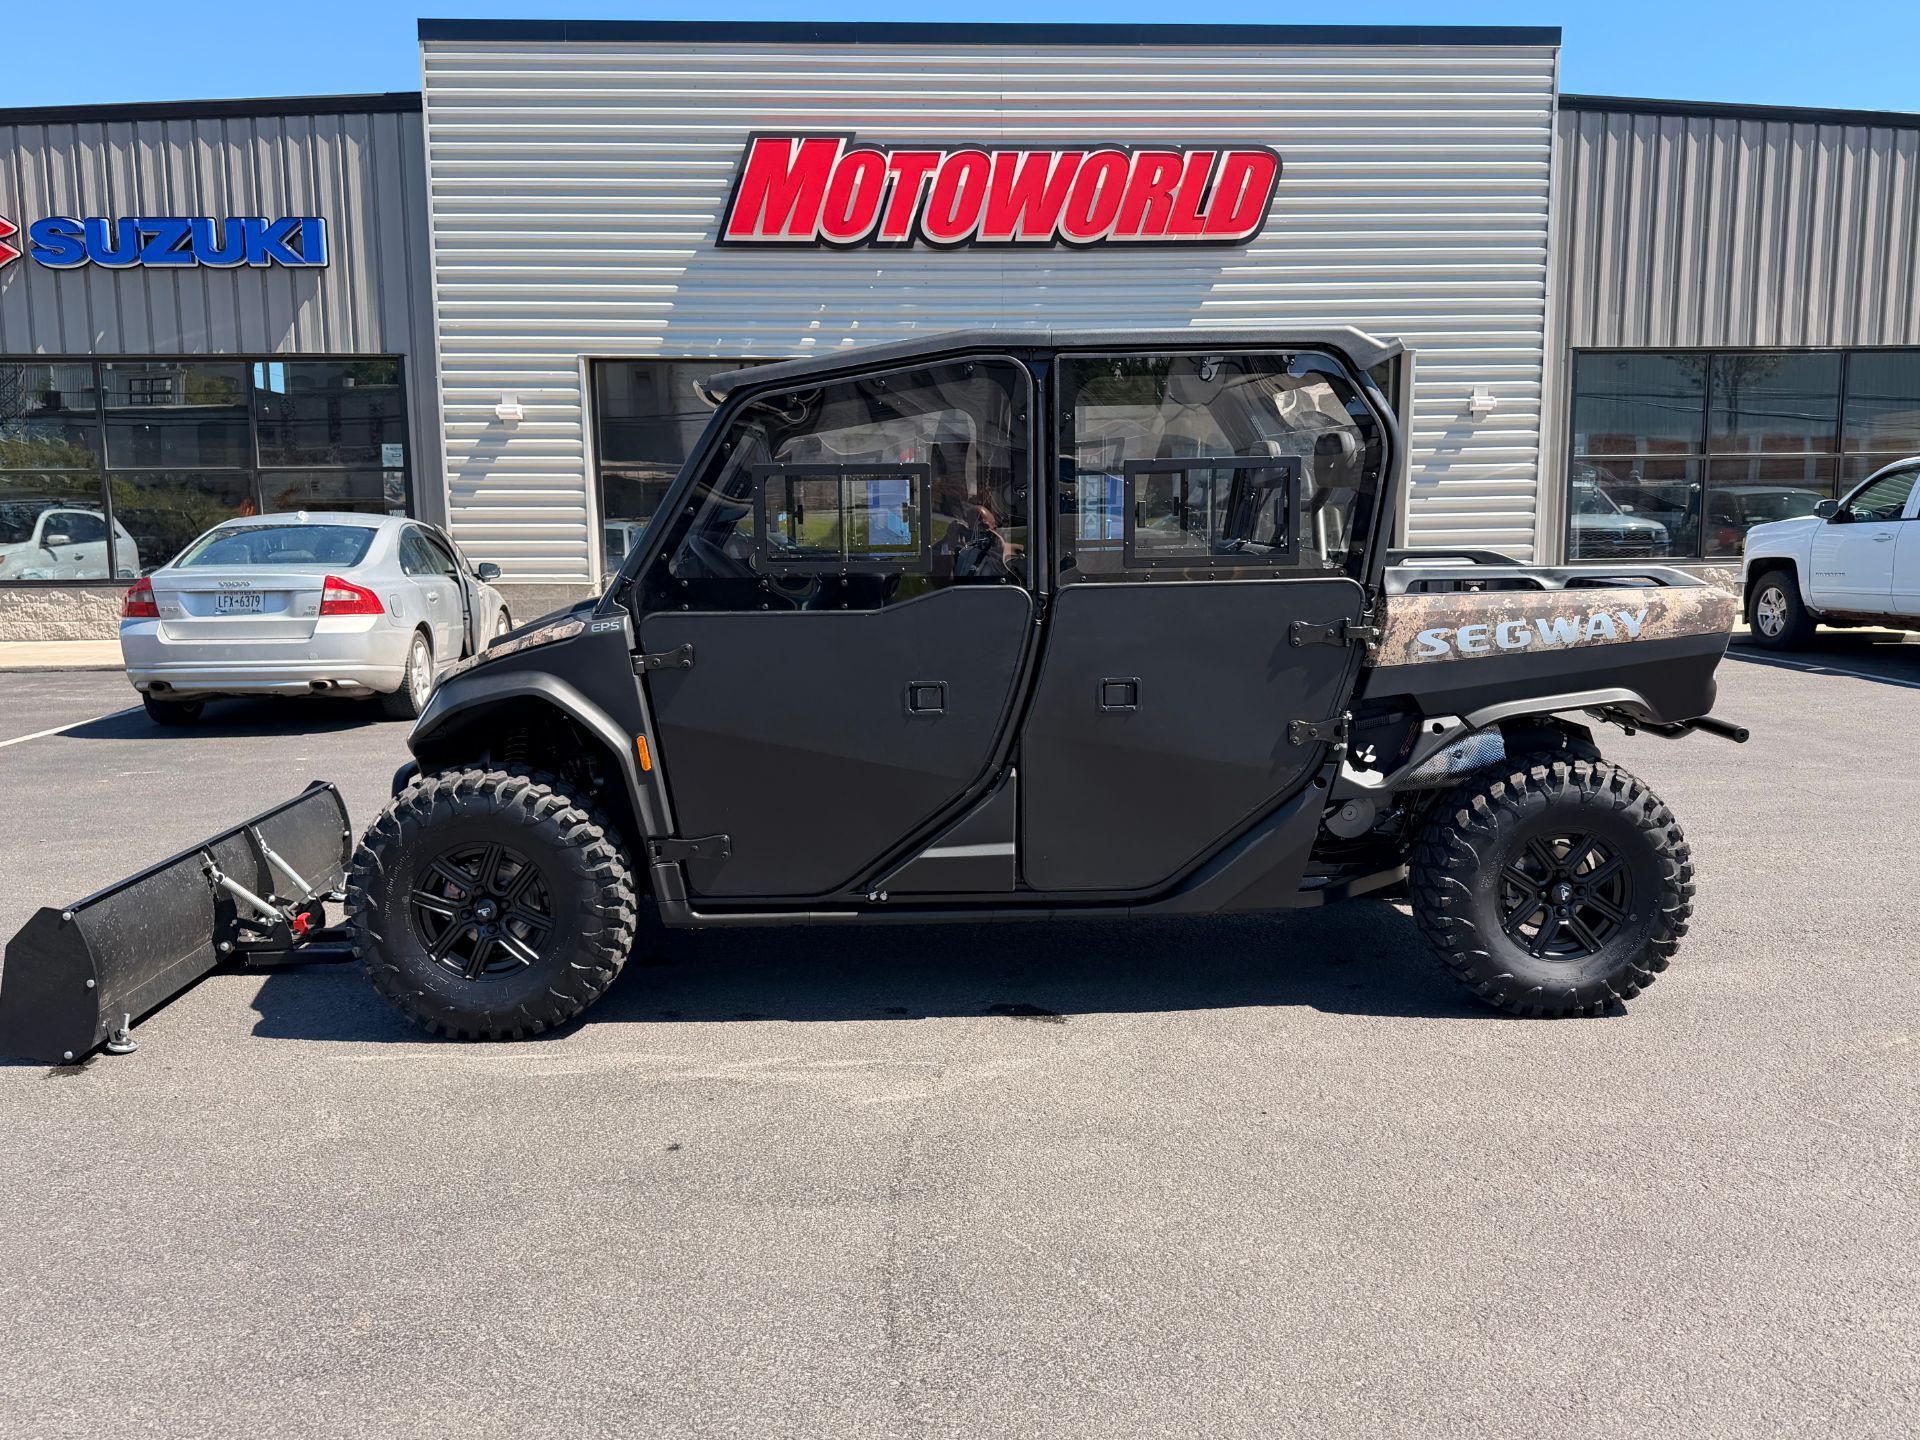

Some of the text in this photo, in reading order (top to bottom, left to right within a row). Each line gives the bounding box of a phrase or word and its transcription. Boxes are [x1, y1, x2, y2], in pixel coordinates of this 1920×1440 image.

[725, 136, 1279, 240] MOTOWORLD
[29, 216, 329, 268] SUZUKI
[591, 621, 620, 632] EPS
[1416, 608, 1648, 658] SEGWAY
